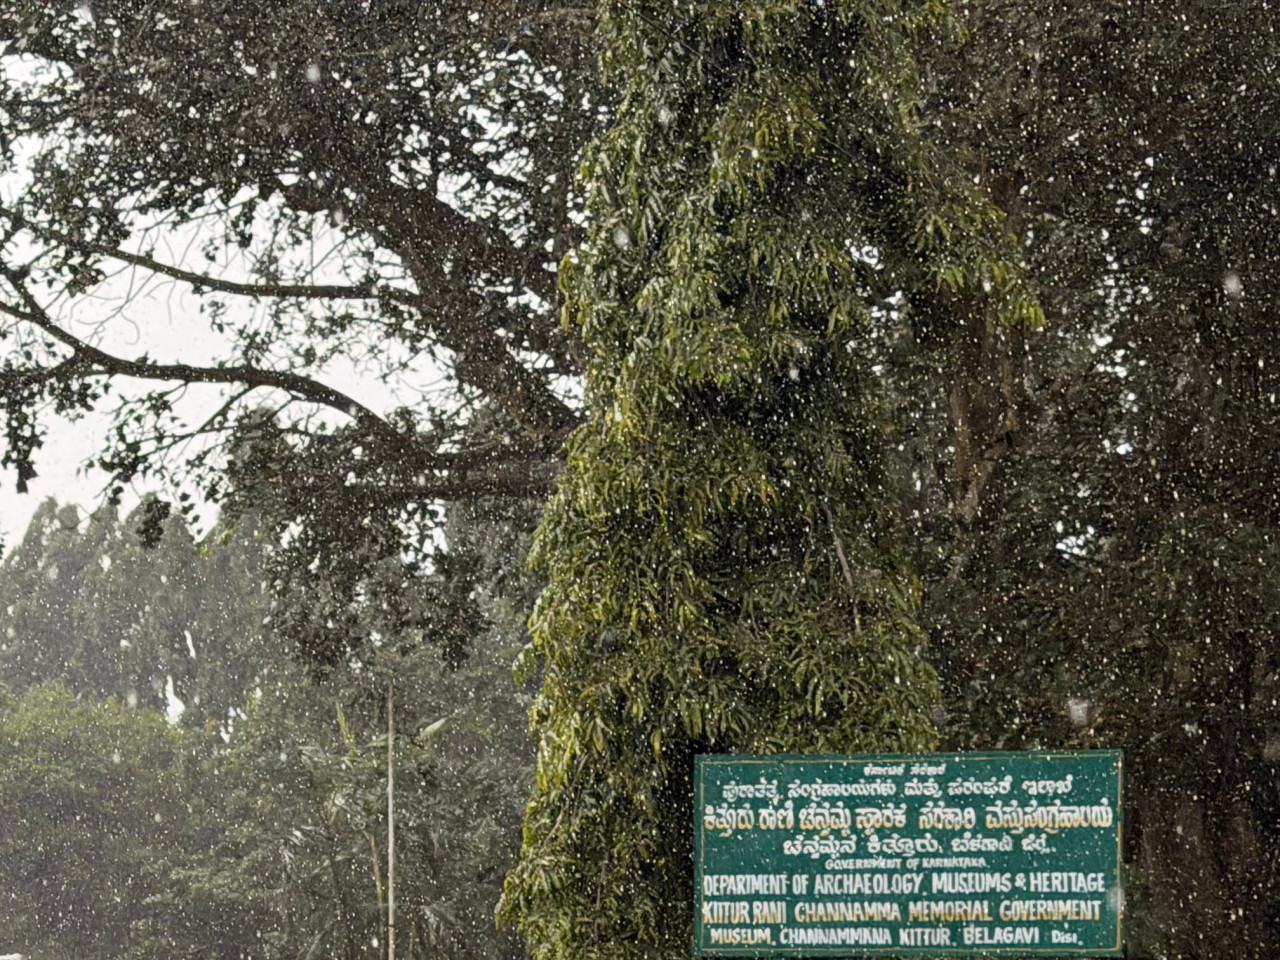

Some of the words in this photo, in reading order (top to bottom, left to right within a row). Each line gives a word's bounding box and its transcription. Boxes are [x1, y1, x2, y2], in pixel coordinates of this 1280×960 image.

[904, 778, 942, 797] ಮತ್ತು
[1022, 774, 1073, 796] ಇಲಾಖೆ
[759, 800, 794, 830] ರಾಣಿ
[855, 803, 906, 835] ಸ್ಮಾರಕ
[985, 797, 1113, 834] ವಸ್ತುಸಂಗ್ರಹಾಲಯ
[825, 858, 901, 870] GOVERNMENT
[906, 859, 919, 870] OF
[704, 875, 787, 896] DEPARTMENT
[792, 875, 808, 894] OF
[932, 873, 1011, 894] MUSEUMS
[1015, 873, 1027, 890] &
[1030, 872, 1105, 892] HERITAGE
[703, 901, 750, 924] KITTUR
[753, 901, 786, 924] RANI
[795, 901, 901, 922] CHANNAMMA
[909, 901, 993, 921] MEMORIAL
[1000, 900, 1101, 921] GOVERNMENT
[780, 927, 891, 945] CHANNAMMANA
[964, 927, 1039, 944] BELAGAVI
